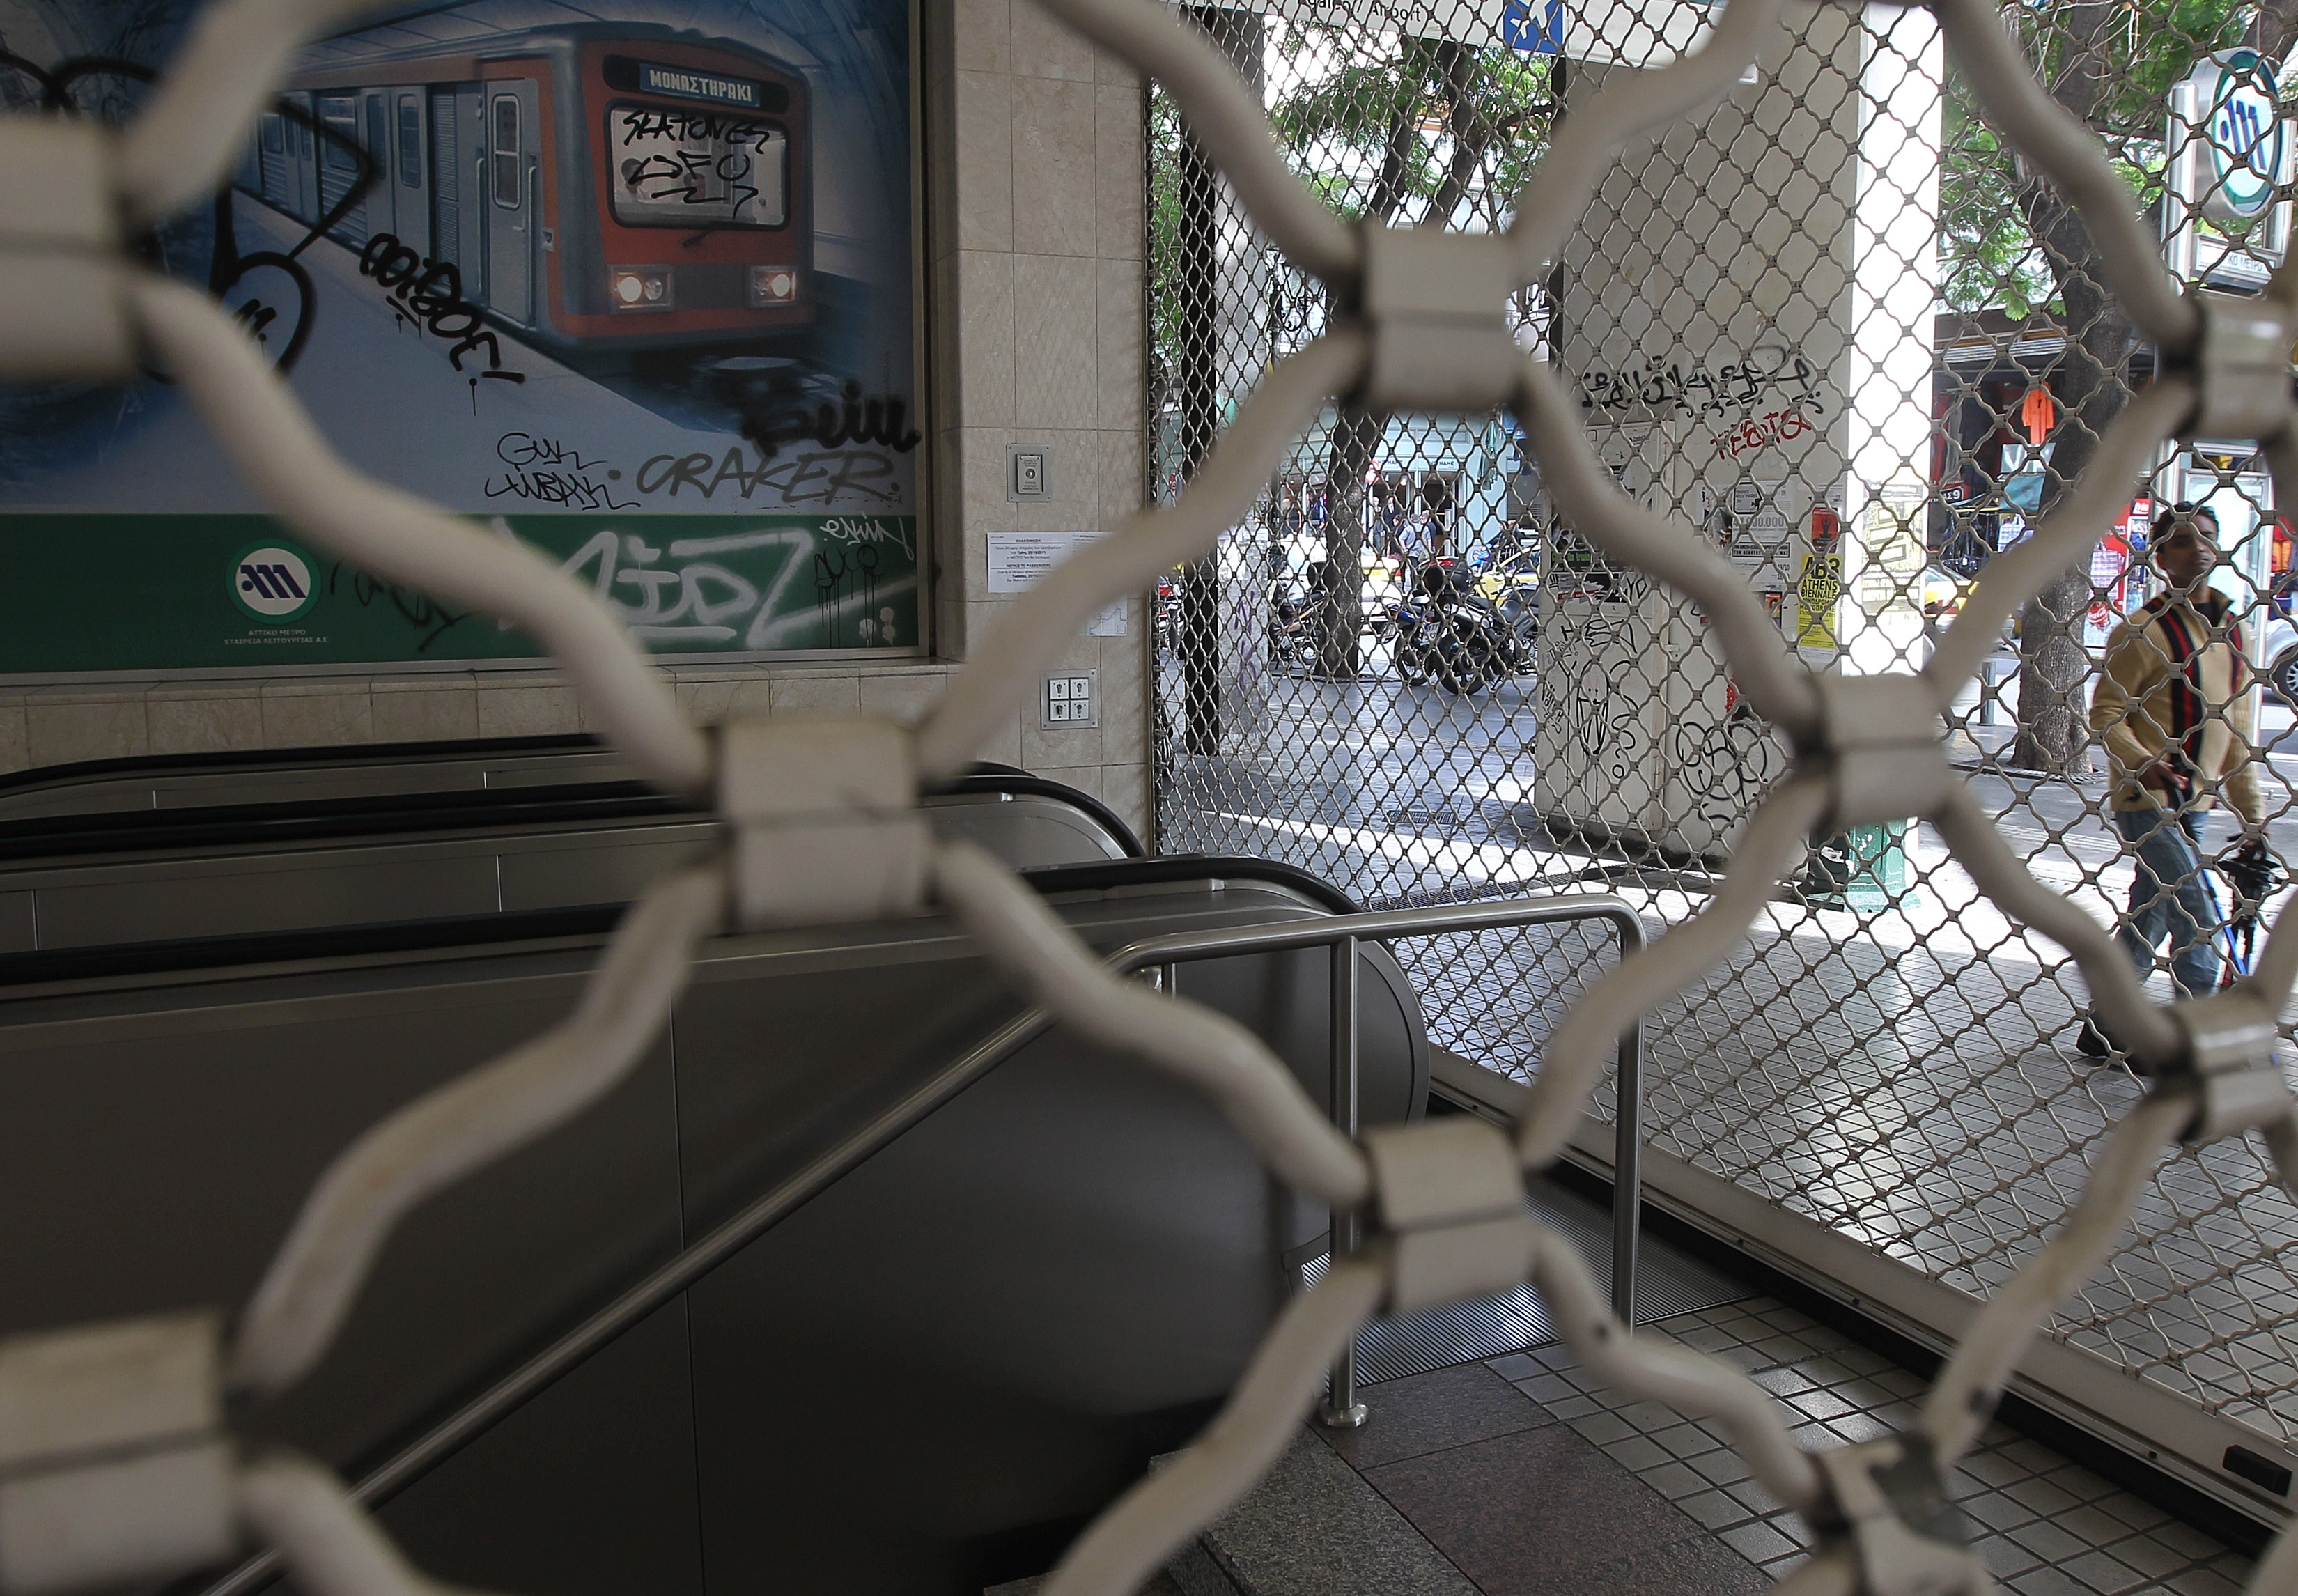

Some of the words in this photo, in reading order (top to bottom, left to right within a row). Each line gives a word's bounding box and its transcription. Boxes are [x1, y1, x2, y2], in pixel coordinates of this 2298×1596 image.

[649, 70, 752, 102] ΜΟΝΑΣΤΗΡΑΚΙ
[1952, 489, 1961, 500] 9
[1802, 580, 1838, 591] ATHENS
[1801, 589, 1837, 599] BIENNALE
